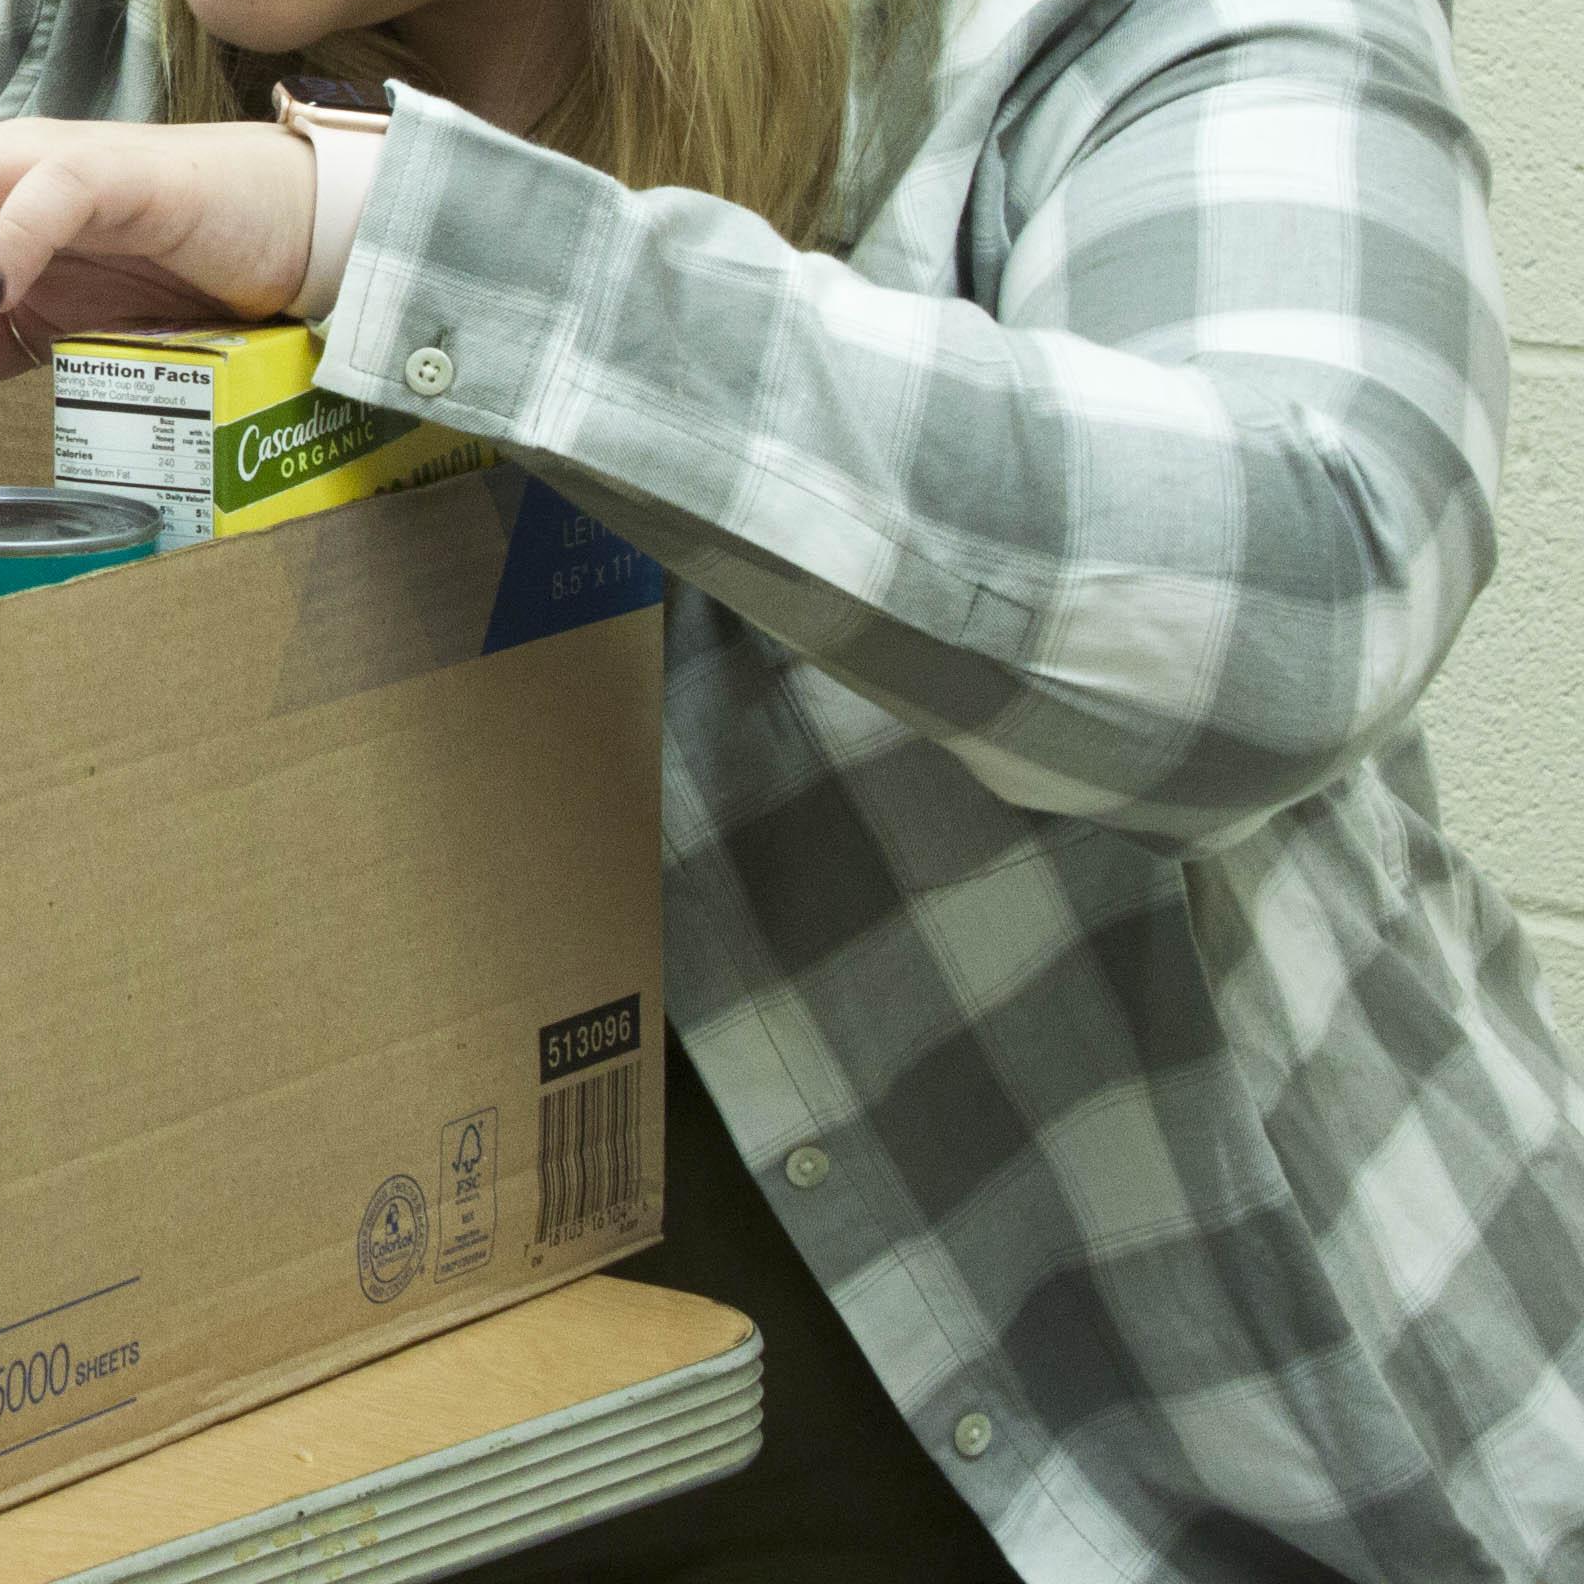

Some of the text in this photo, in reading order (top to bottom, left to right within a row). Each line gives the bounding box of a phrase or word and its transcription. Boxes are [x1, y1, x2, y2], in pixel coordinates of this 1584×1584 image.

[55, 357, 211, 385] Nutrition Facts
[56, 374, 85, 388] Serving
[88, 376, 106, 388] Size
[115, 381, 132, 391] cup
[134, 380, 156, 394] (60g)
[56, 385, 186, 406] Servings Per Container about 6
[152, 425, 175, 434] Crunch
[159, 417, 176, 426] Buzz
[65, 434, 89, 446] Serving
[237, 399, 352, 482] Cascadian
[280, 420, 374, 478] ORGANIC
[55, 447, 211, 471] Calories 240 280
[60, 463, 211, 488] Calories from Fat 25 30
[165, 492, 183, 503] Daily
[547, 1009, 632, 1068] 513096
[75, 1340, 141, 1389] SHEETS
